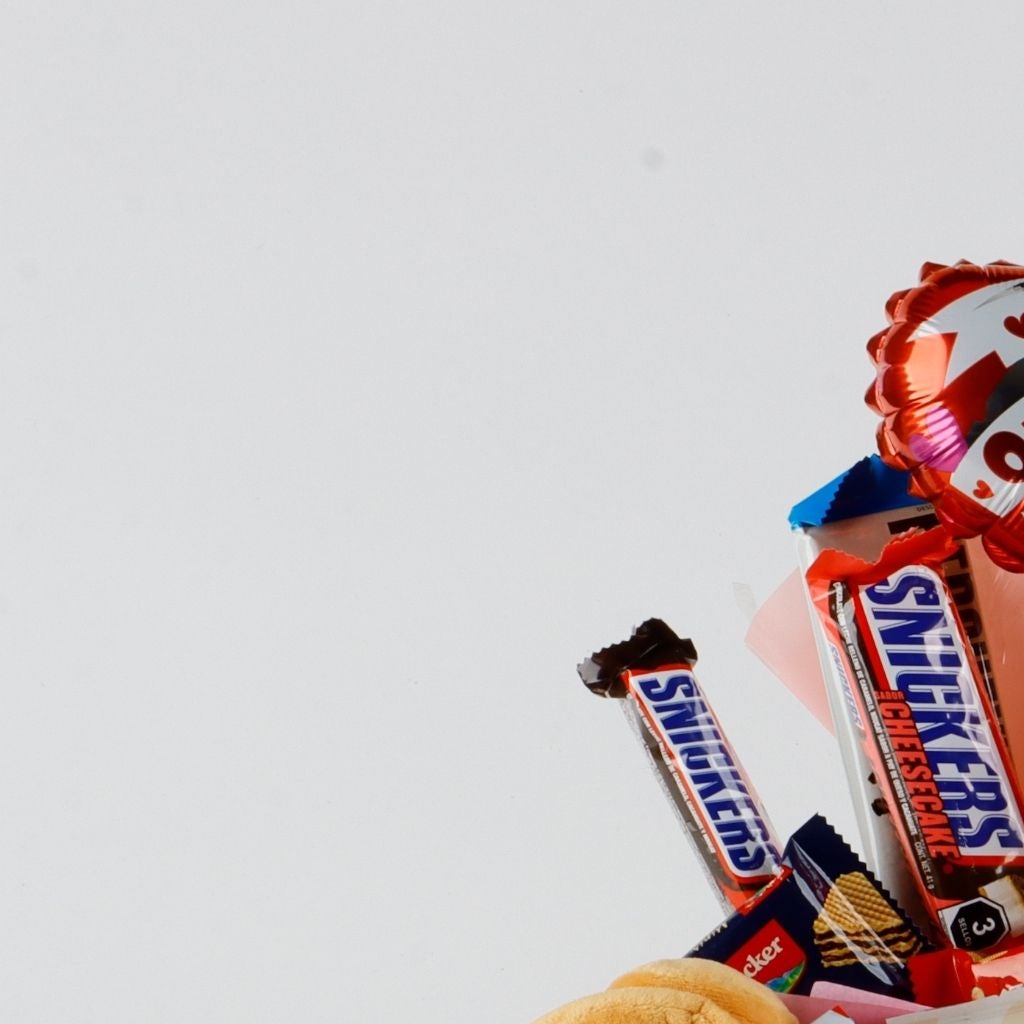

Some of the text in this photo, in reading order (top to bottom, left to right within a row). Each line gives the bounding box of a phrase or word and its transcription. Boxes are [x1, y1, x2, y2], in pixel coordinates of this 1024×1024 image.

[639, 676, 782, 872] SNICKERS
[865, 574, 1024, 849] SNICKERS
[879, 702, 961, 859] CHEESECAKE
[972, 917, 996, 936] 3
